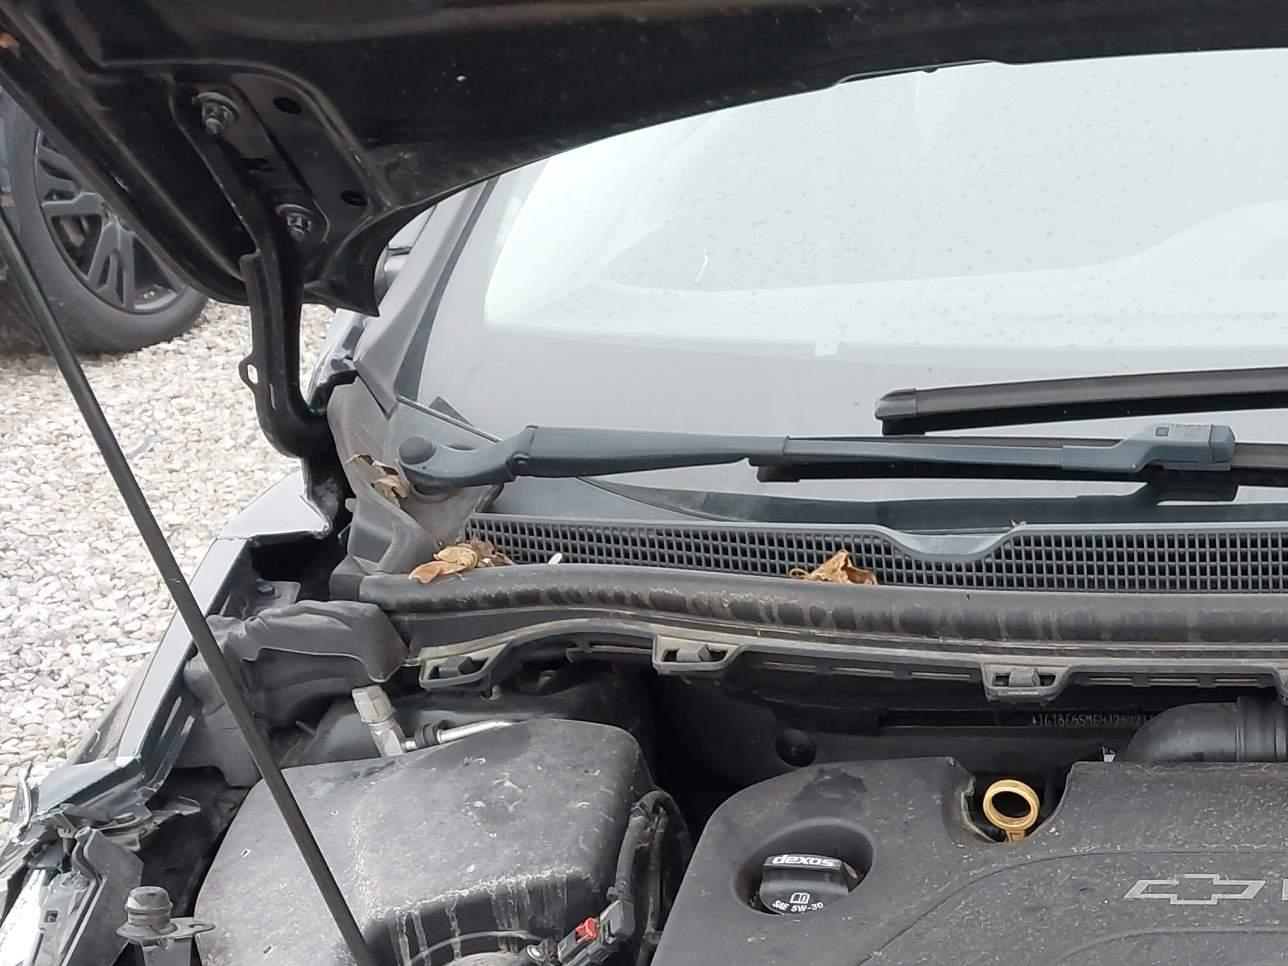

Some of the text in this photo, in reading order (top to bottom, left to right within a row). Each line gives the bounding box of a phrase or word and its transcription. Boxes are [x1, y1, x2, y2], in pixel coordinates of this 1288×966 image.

[772, 855, 834, 866] dexos
[772, 900, 824, 912] SAE 5W-30
